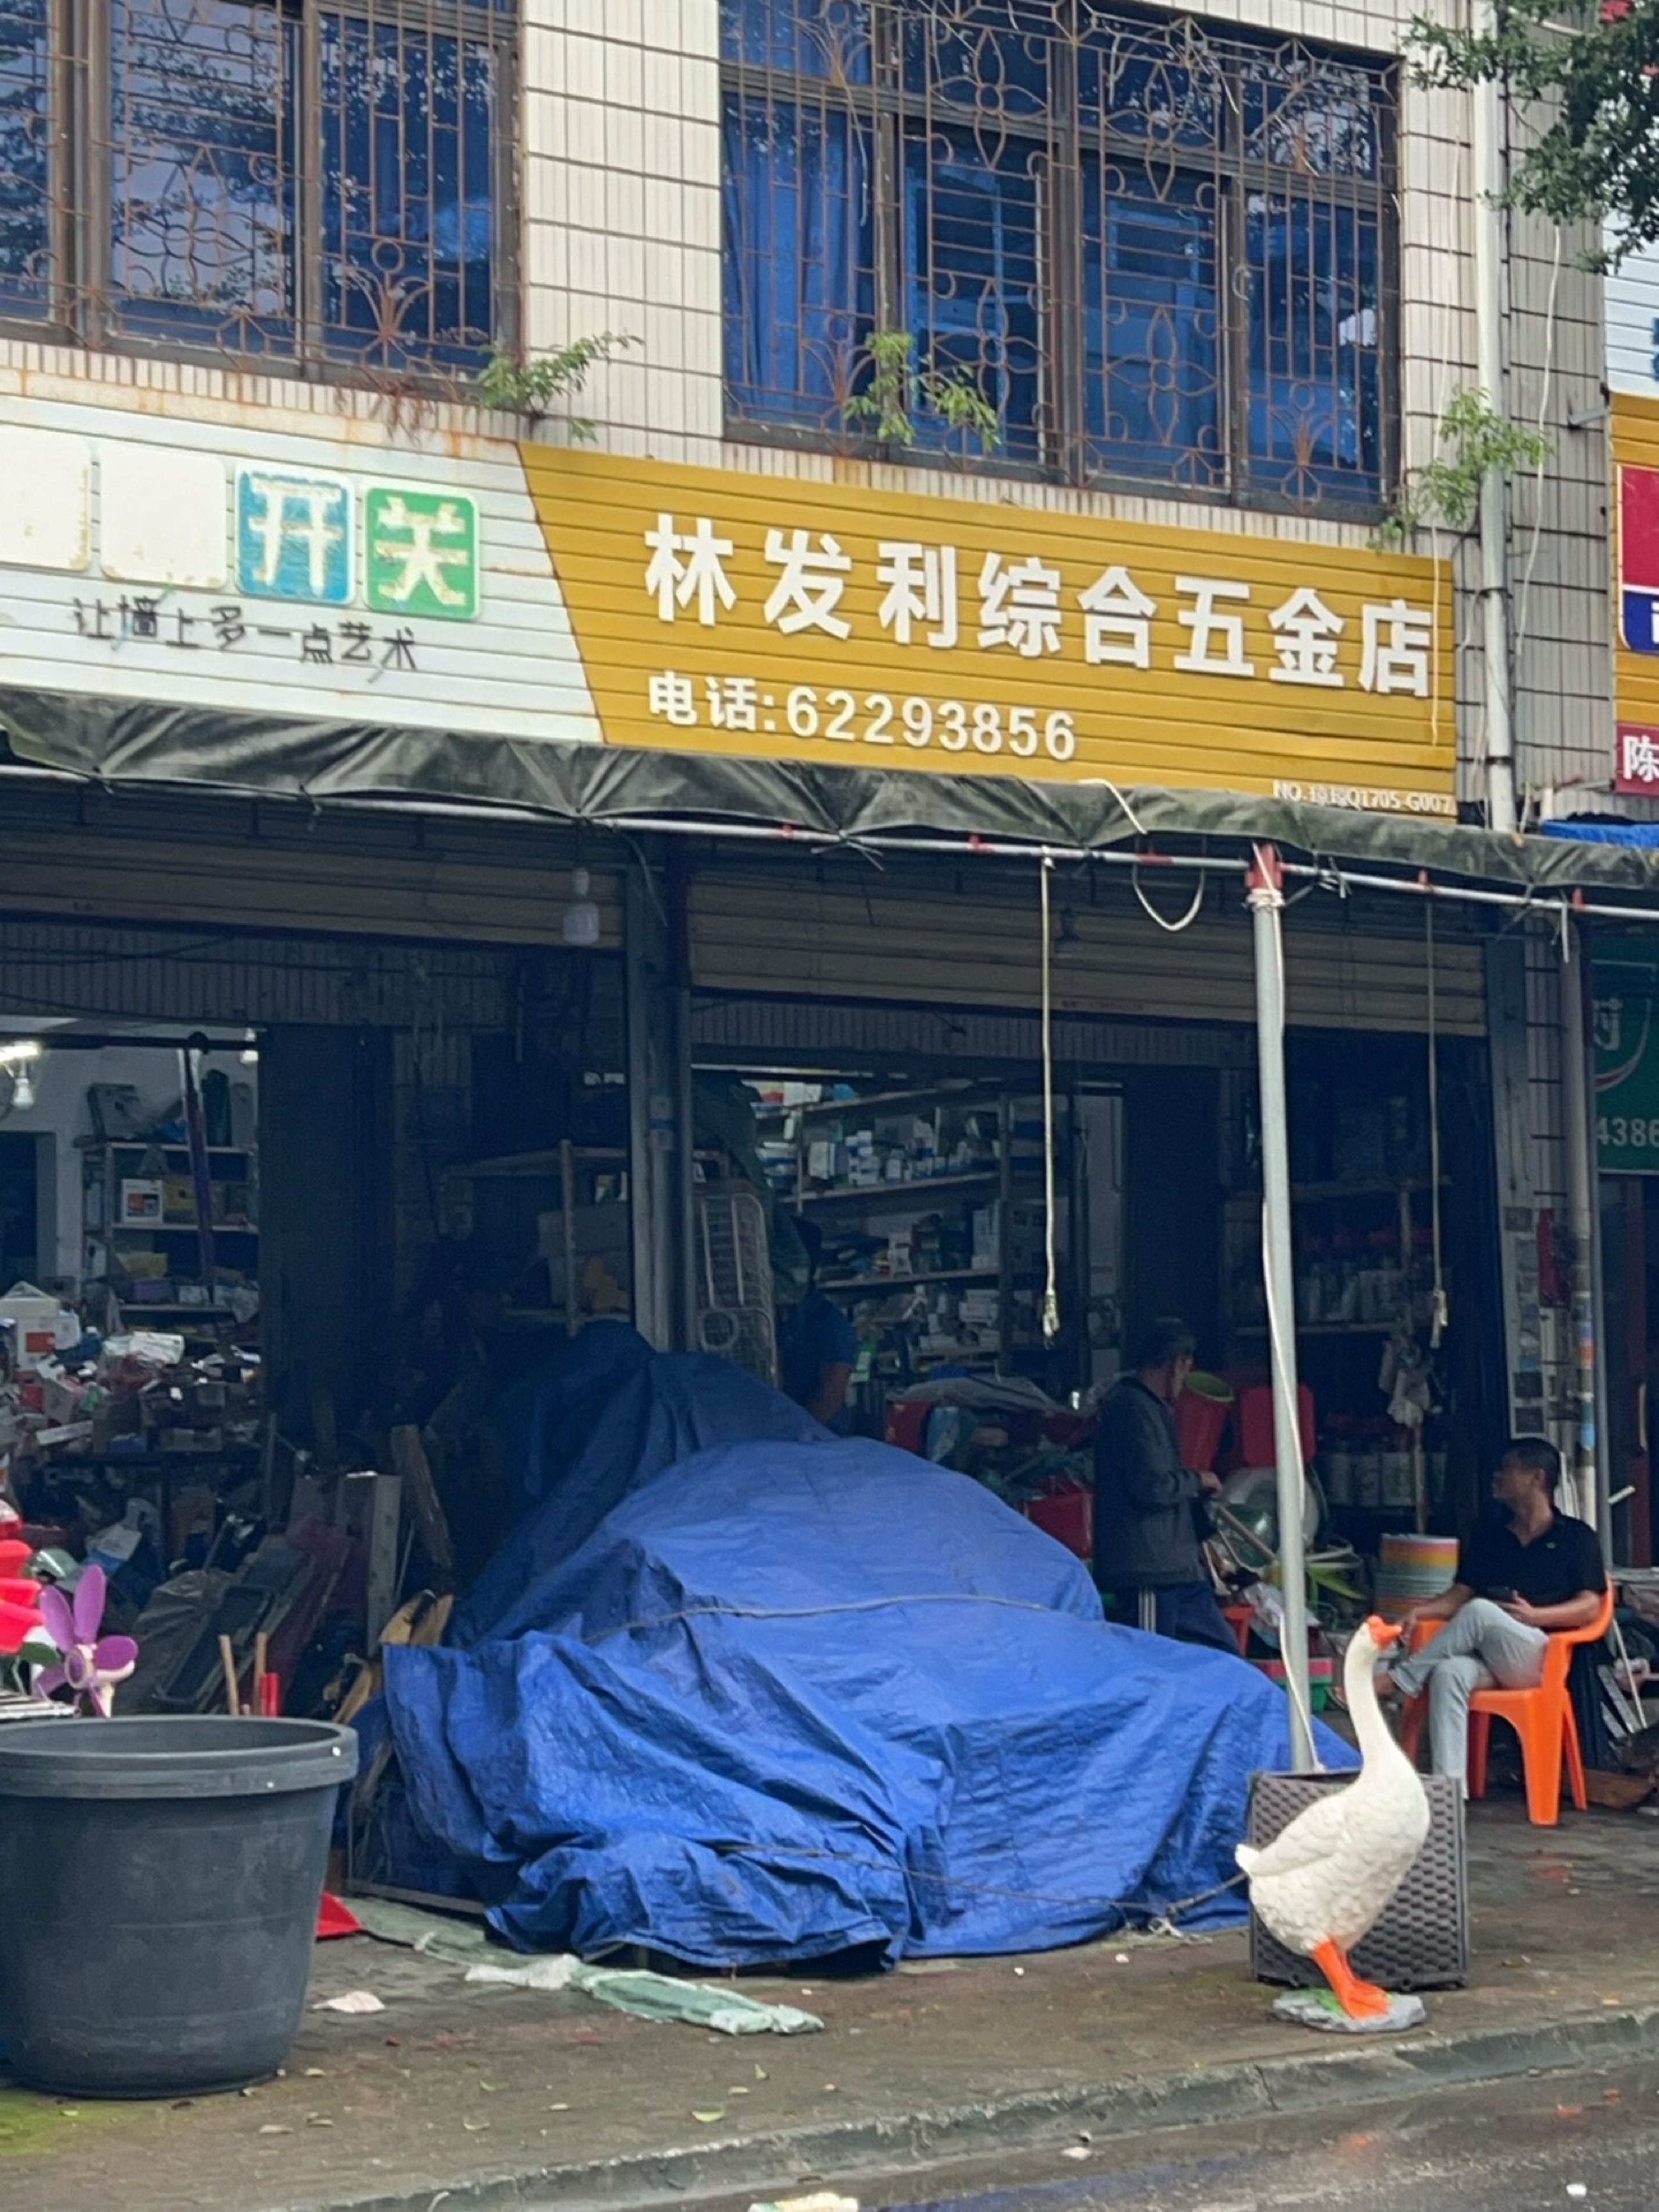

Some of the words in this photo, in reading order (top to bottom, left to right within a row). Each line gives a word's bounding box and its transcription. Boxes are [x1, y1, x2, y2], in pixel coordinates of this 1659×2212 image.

[248, 475, 468, 608] 开关
[72, 594, 417, 670] 让墙上多一点艺术
[644, 513, 1434, 697] 林发利综合五金店
[648, 670, 1076, 762] 电话:62293856
